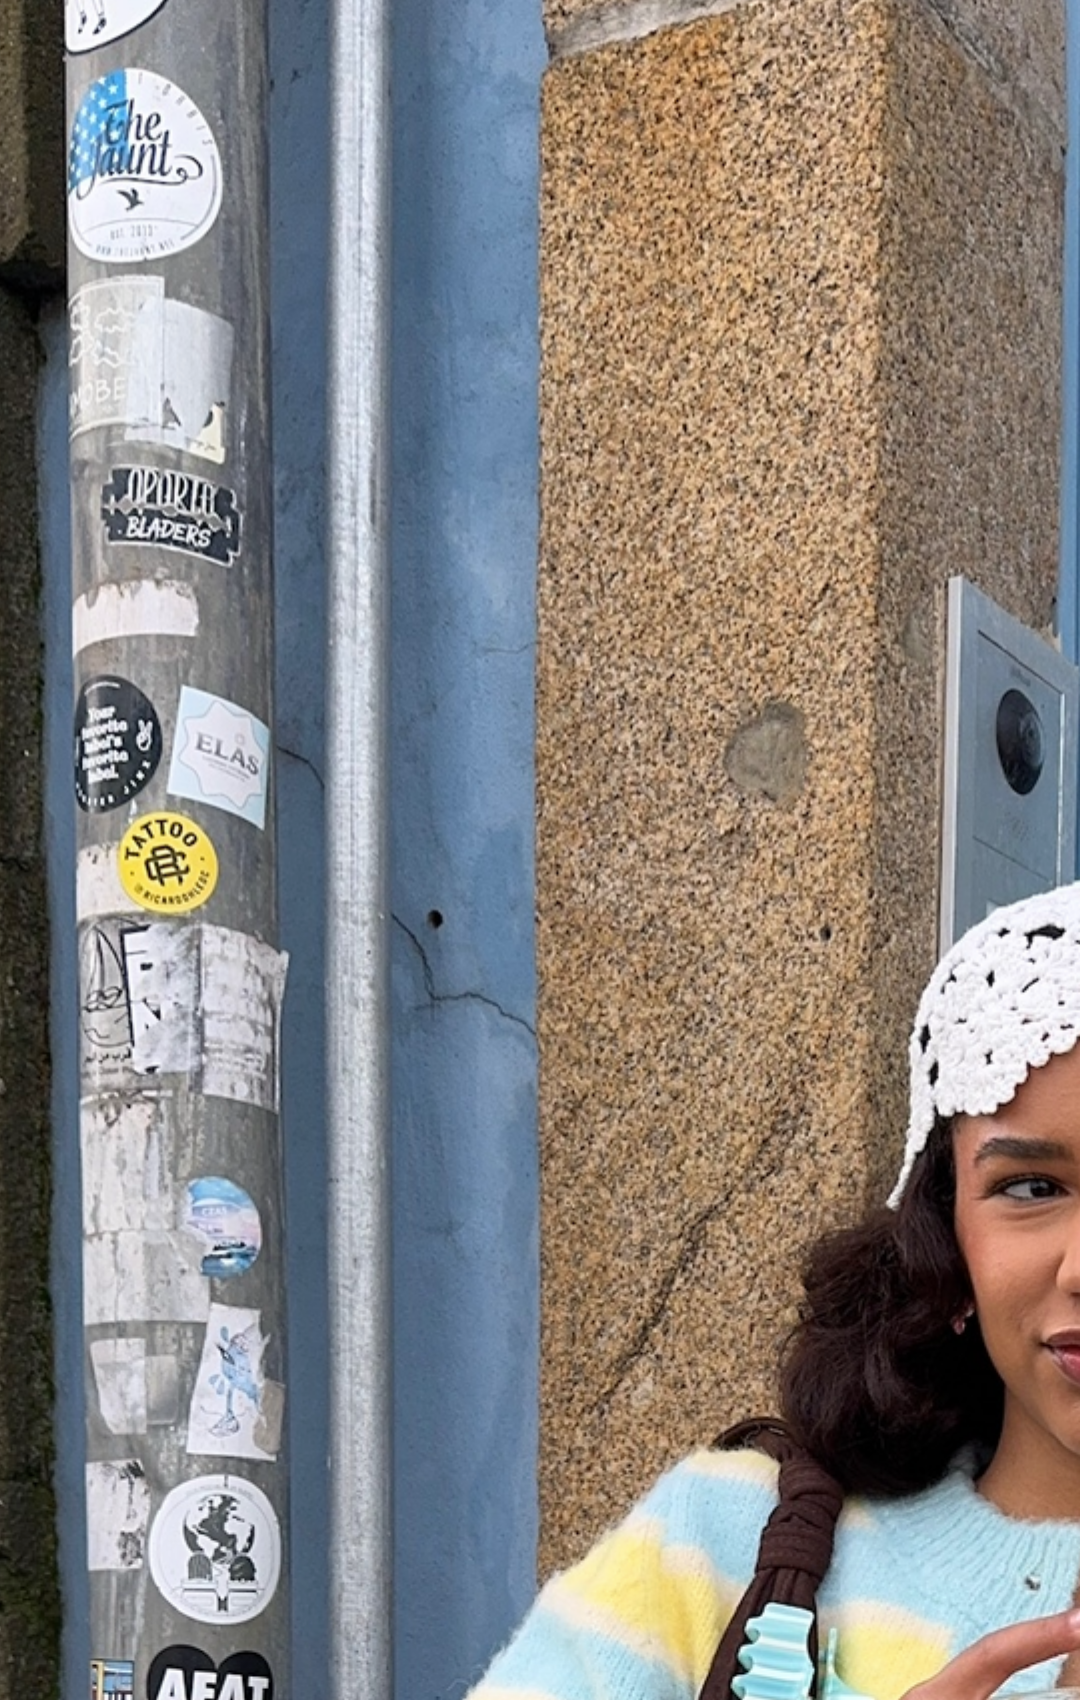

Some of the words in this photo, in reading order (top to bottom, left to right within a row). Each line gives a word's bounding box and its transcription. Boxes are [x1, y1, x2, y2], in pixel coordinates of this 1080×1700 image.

[103, 98, 162, 147] The
[125, 515, 212, 548] BLADERS
[195, 732, 259, 776] ELAS
[124, 819, 197, 861] TATTOO
